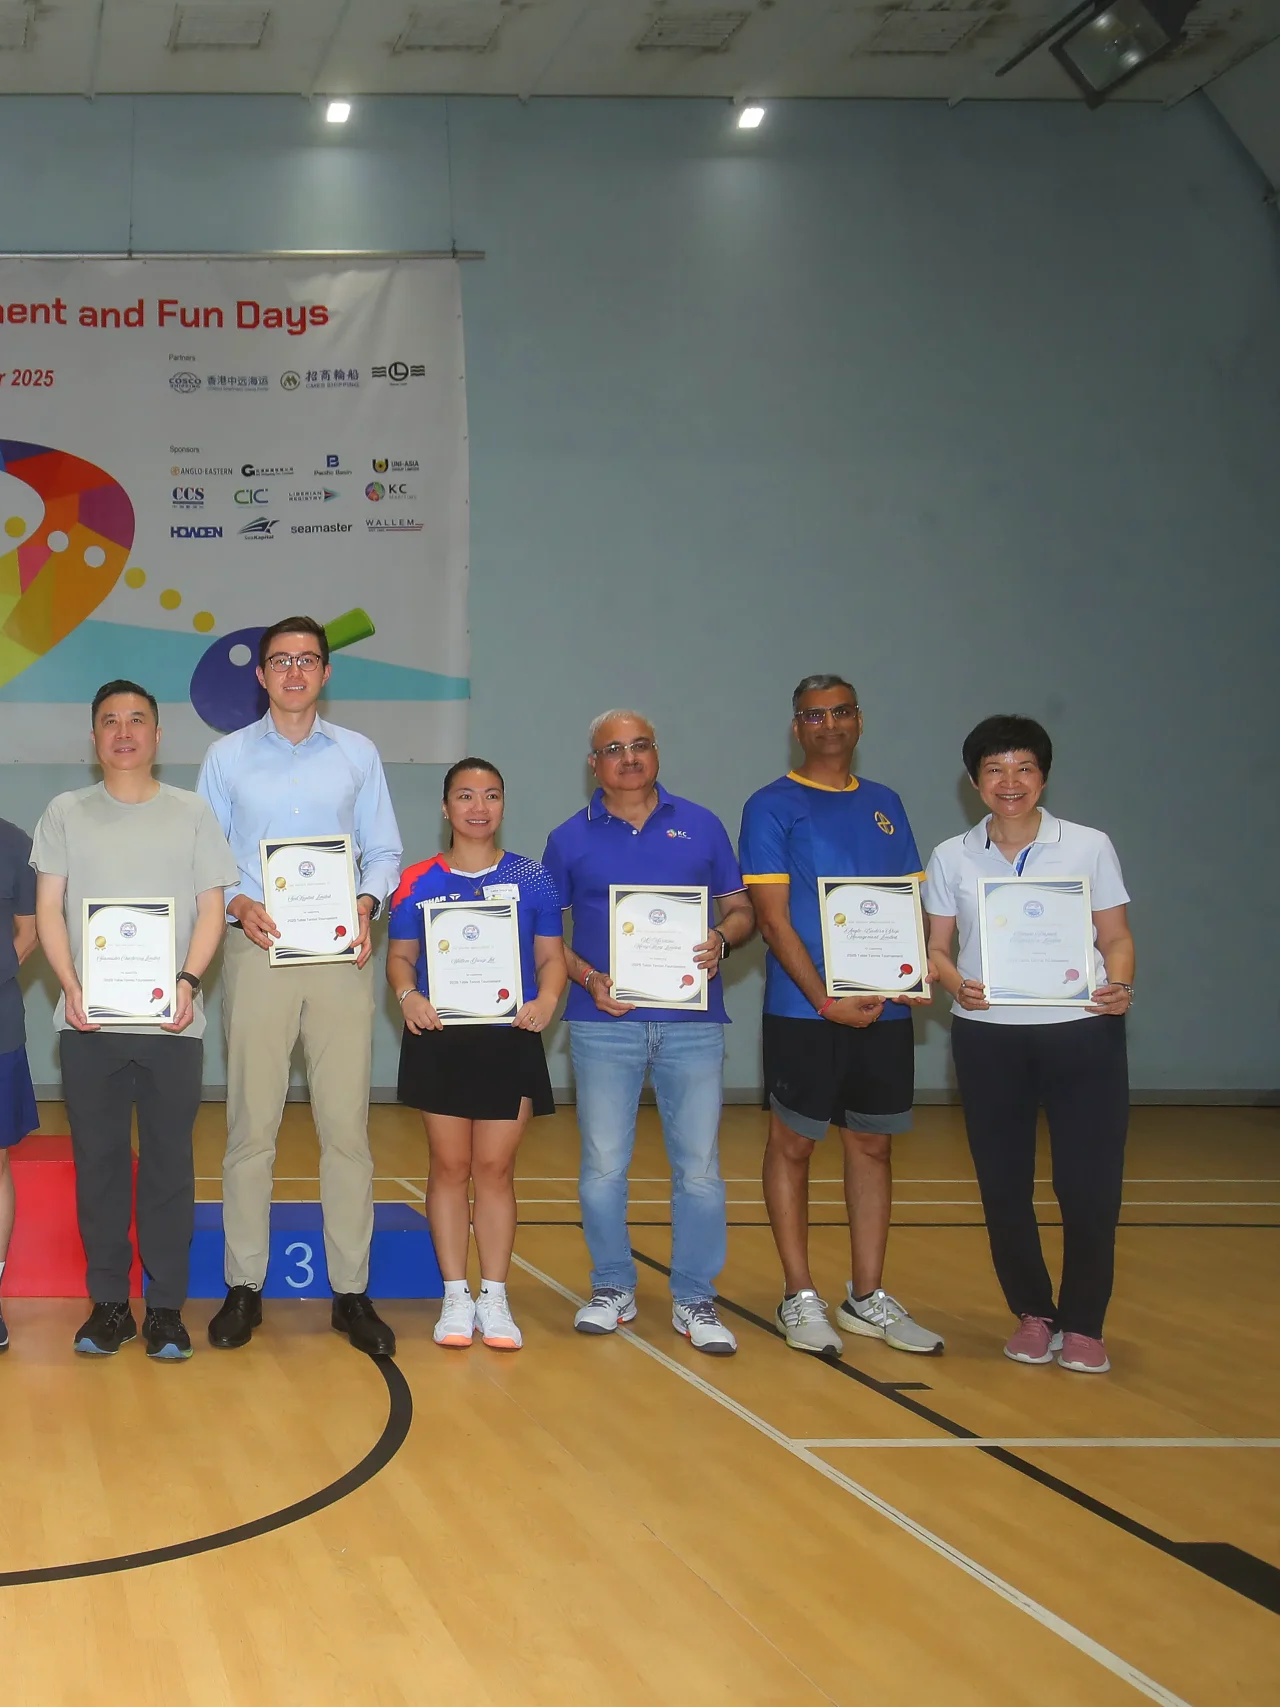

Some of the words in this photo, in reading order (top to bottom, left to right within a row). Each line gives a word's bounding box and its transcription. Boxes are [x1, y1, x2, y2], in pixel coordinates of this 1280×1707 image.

[79, 299, 145, 330] and
[158, 300, 224, 330] Fun
[237, 301, 330, 336] Days
[168, 354, 196, 362] Partners
[11, 369, 55, 387] 2025
[207, 375, 269, 387] 香港中远海运
[169, 445, 200, 454] Sponsors
[391, 460, 420, 468] UNI-ASIA
[180, 467, 233, 476] ANGLO-EASTERN
[172, 486, 205, 501] CCS
[290, 522, 353, 535] seamaster
[365, 518, 416, 527] WALLEM
[170, 526, 223, 538] HOWDEN
[284, 1241, 315, 1289] 3
